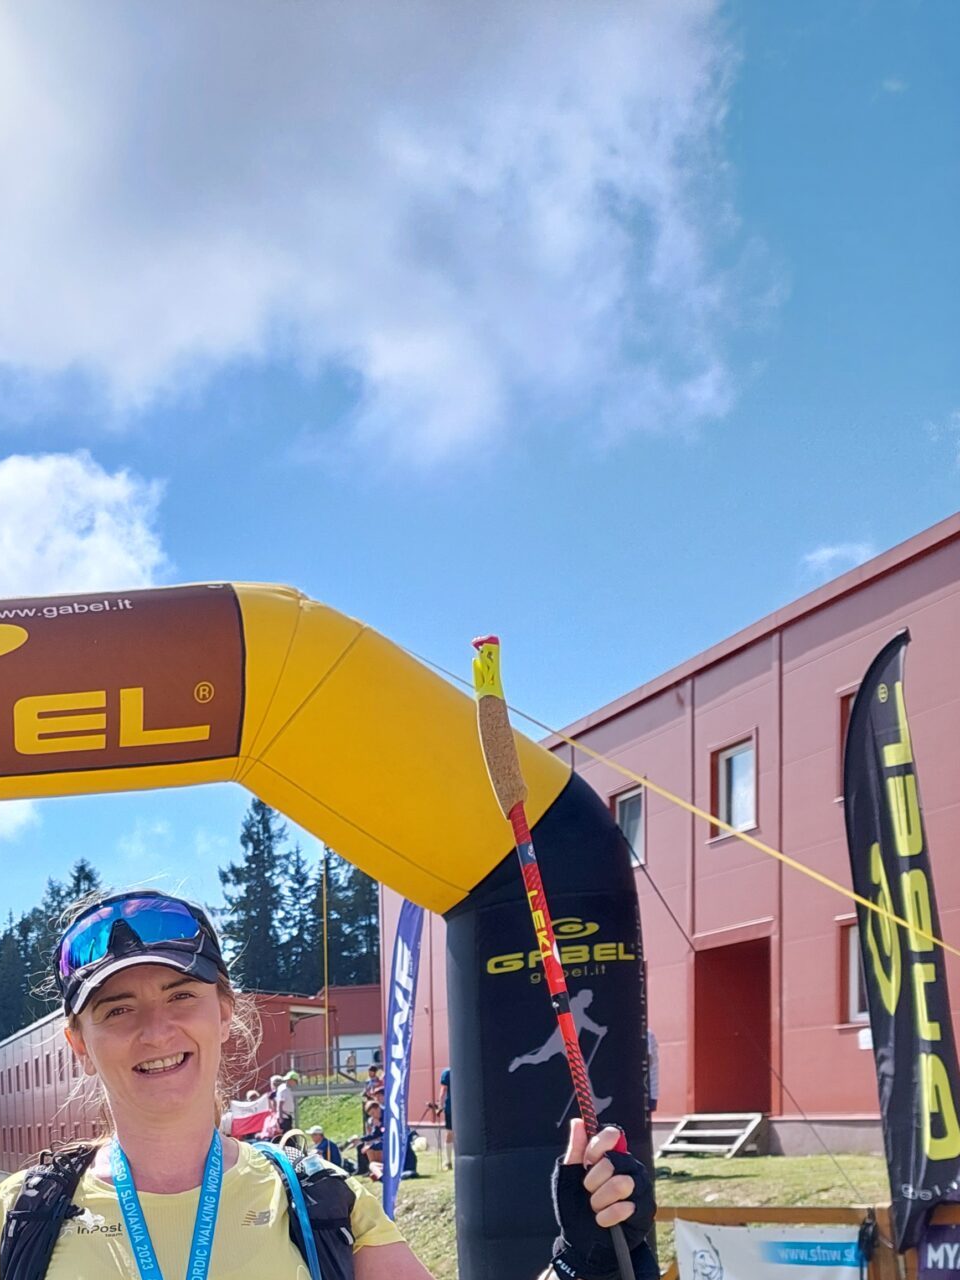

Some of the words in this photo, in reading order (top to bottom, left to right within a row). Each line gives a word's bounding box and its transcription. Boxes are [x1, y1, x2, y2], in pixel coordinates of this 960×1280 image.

[529, 964, 607, 984] gel.it
[388, 935, 414, 1178] ONWF
[206, 1156, 221, 1195] WORLD
[76, 1222, 123, 1235] InPost
[120, 1189, 145, 1243] SLOVAKIA
[136, 1244, 154, 1270] 2023
[198, 1195, 217, 1248] WALKING
[555, 1259, 577, 1278] PULL
[927, 1242, 960, 1270] MY
